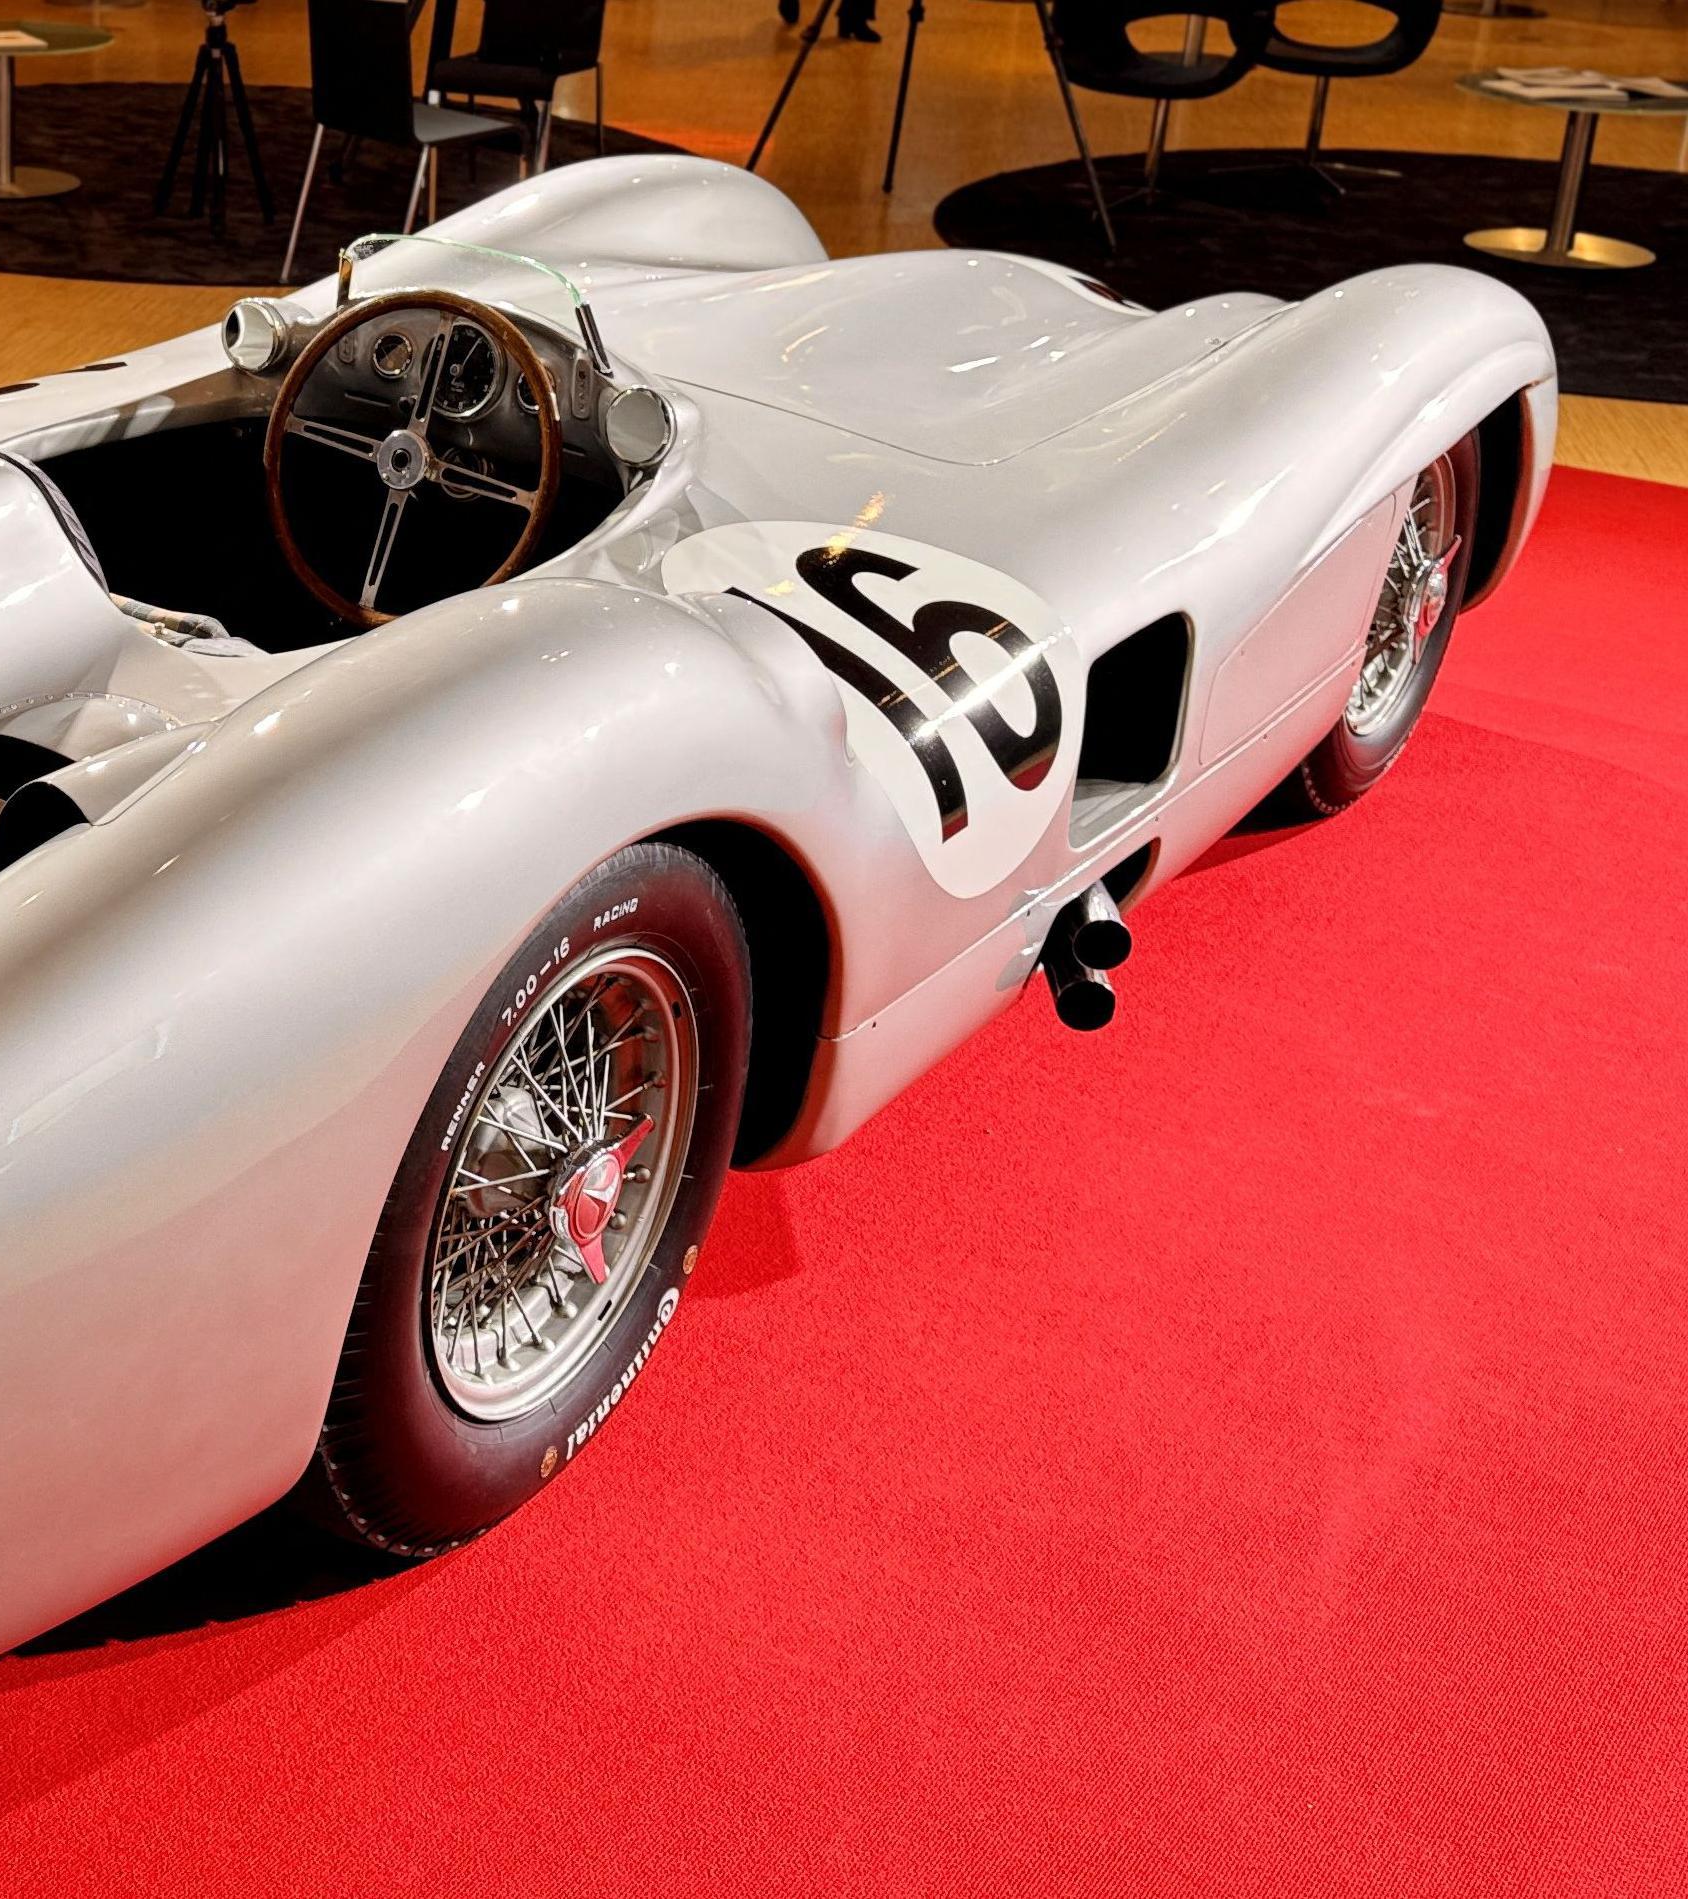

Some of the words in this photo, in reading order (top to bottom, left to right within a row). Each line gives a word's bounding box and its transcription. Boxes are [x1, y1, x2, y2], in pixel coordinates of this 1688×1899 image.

[723, 546, 1062, 844] 16
[440, 1061, 486, 1151] RENNER
[593, 898, 639, 932] RACING
[566, 1287, 680, 1460] Continental
